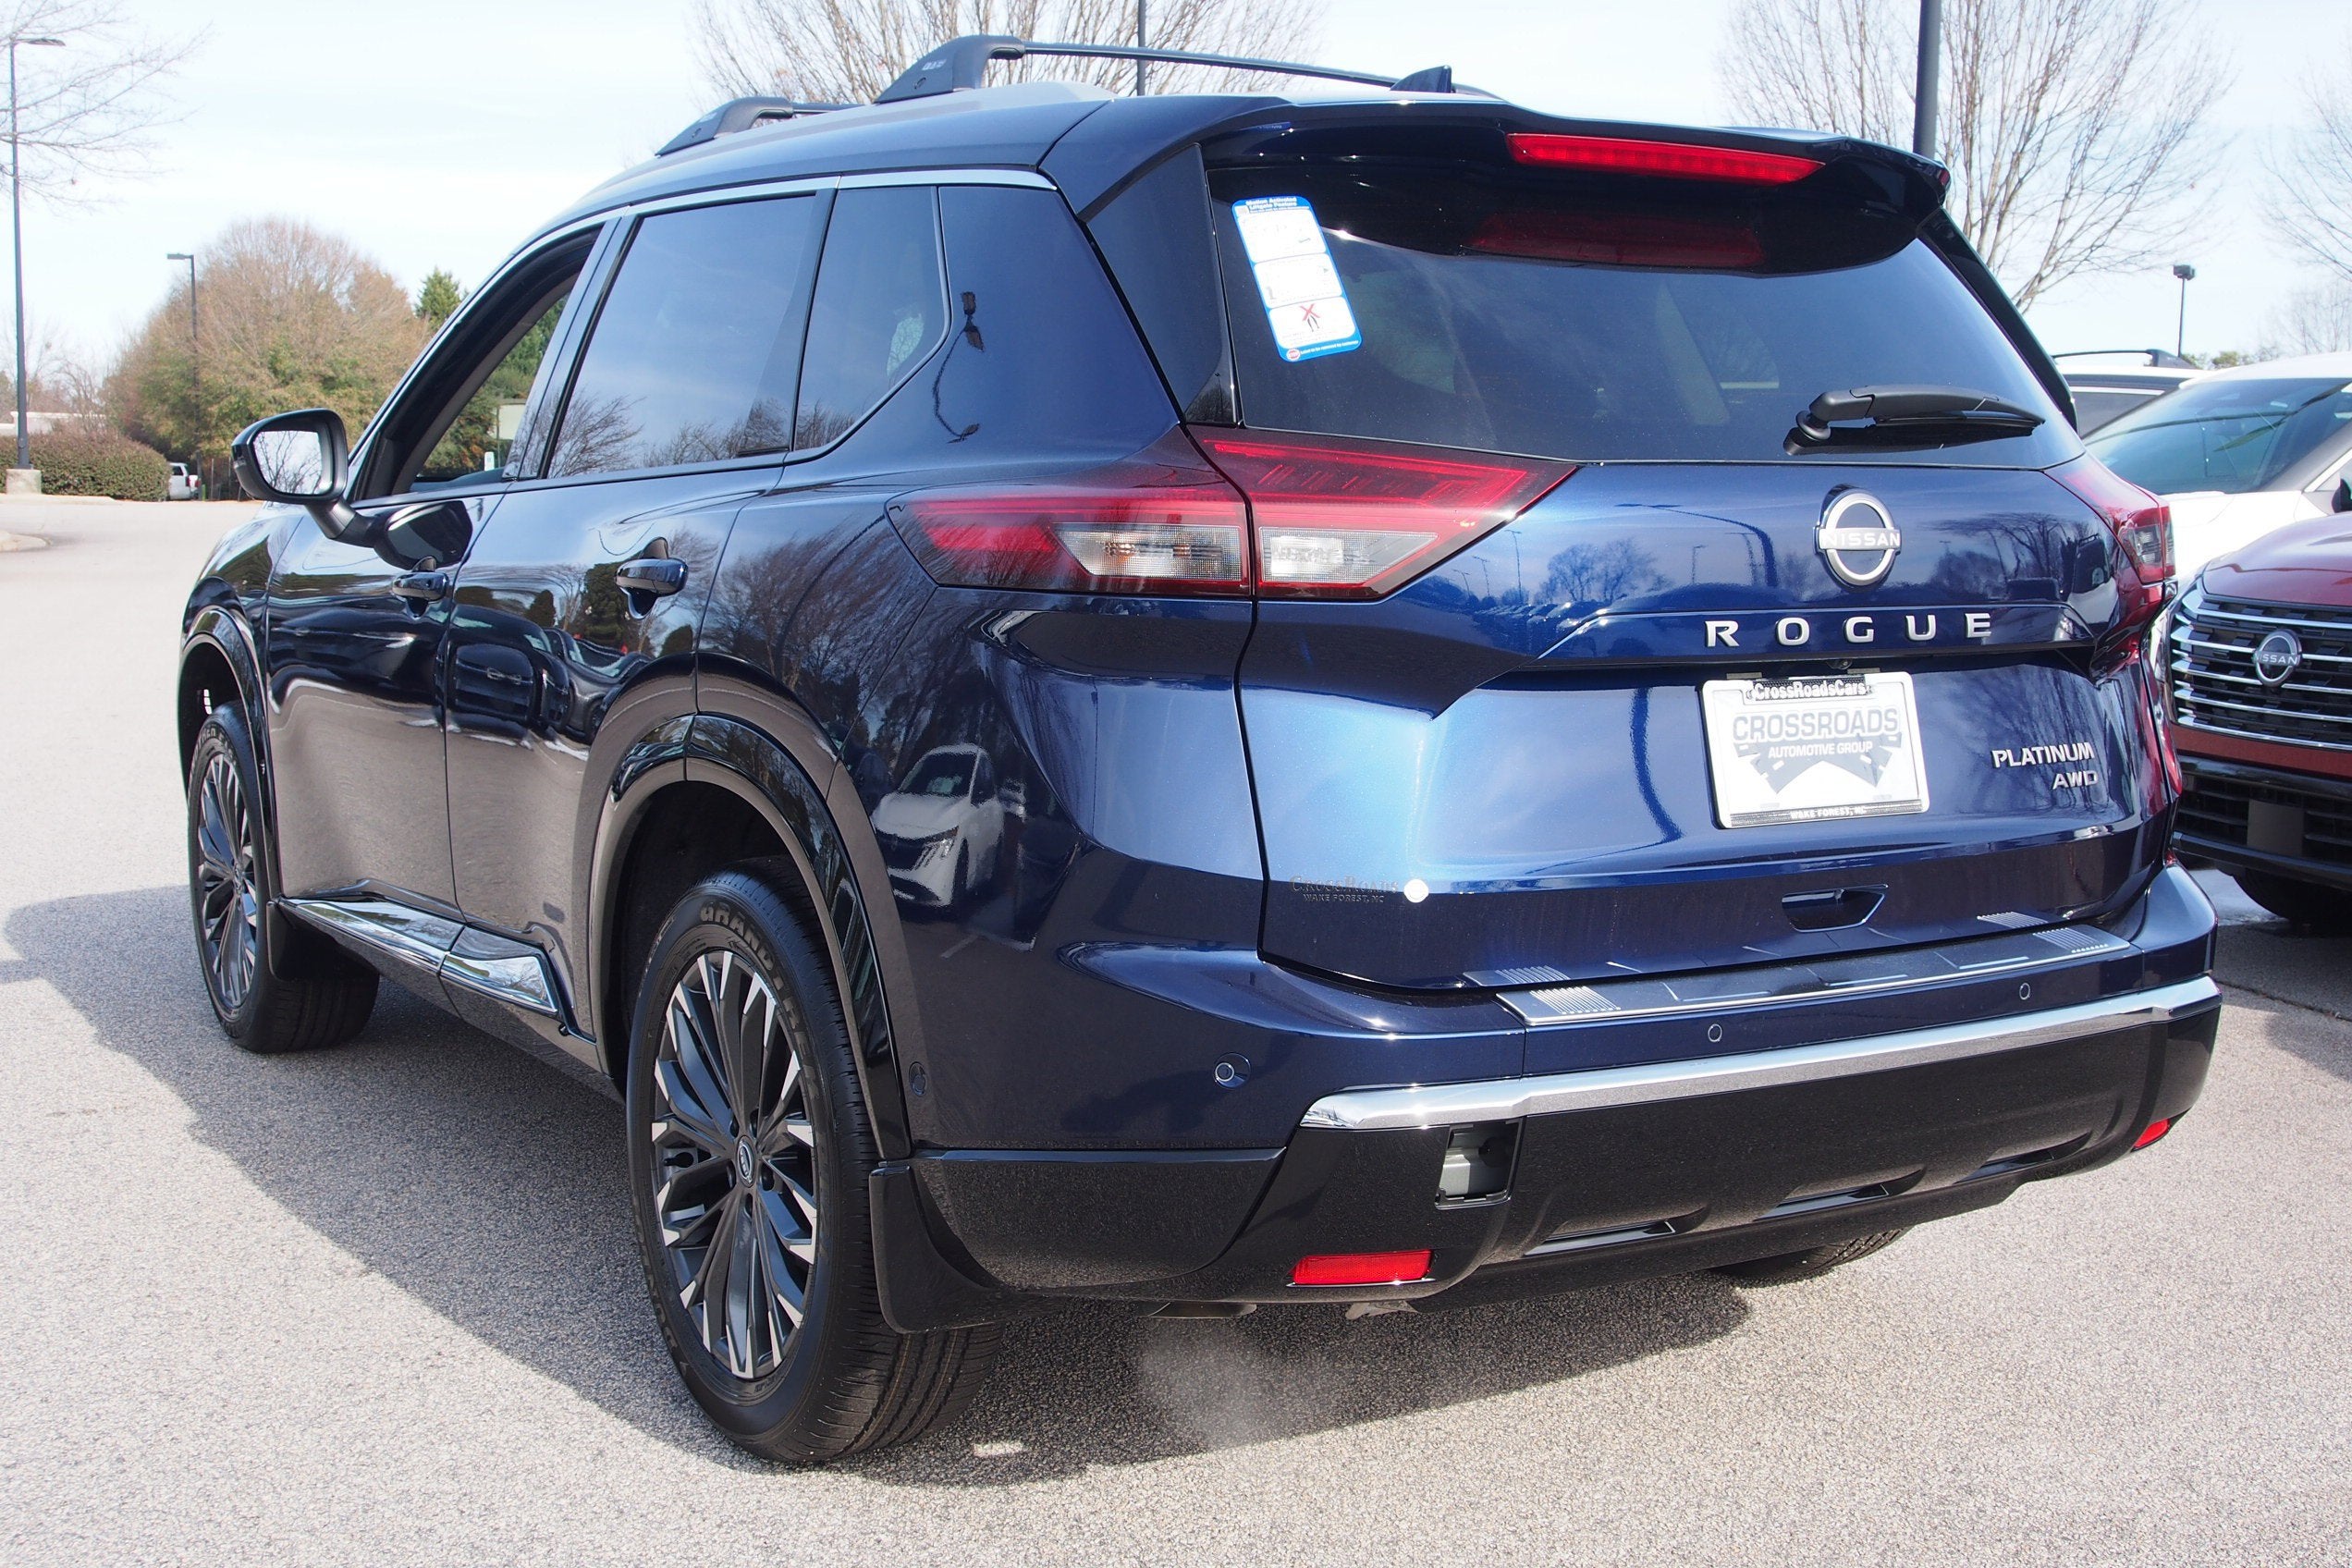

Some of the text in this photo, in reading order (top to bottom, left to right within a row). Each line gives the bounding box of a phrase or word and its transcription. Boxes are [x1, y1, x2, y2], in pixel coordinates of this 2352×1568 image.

[1821, 532, 1901, 548] NISSAN
[1704, 612, 1992, 648] ROGUE
[2253, 652, 2299, 666] NISSAN
[1754, 679, 1867, 702] CrossRoadsCars
[1733, 707, 1899, 741] CROSSROADS
[1768, 741, 1873, 759] AUTOMOTIVE GROUP
[1991, 741, 2095, 768] PLATINUM
[2052, 769, 2099, 790] AWD
[1790, 808, 1816, 820] WAKE
[1303, 893, 1330, 902] WAKE
[1371, 894, 1385, 903] NC
